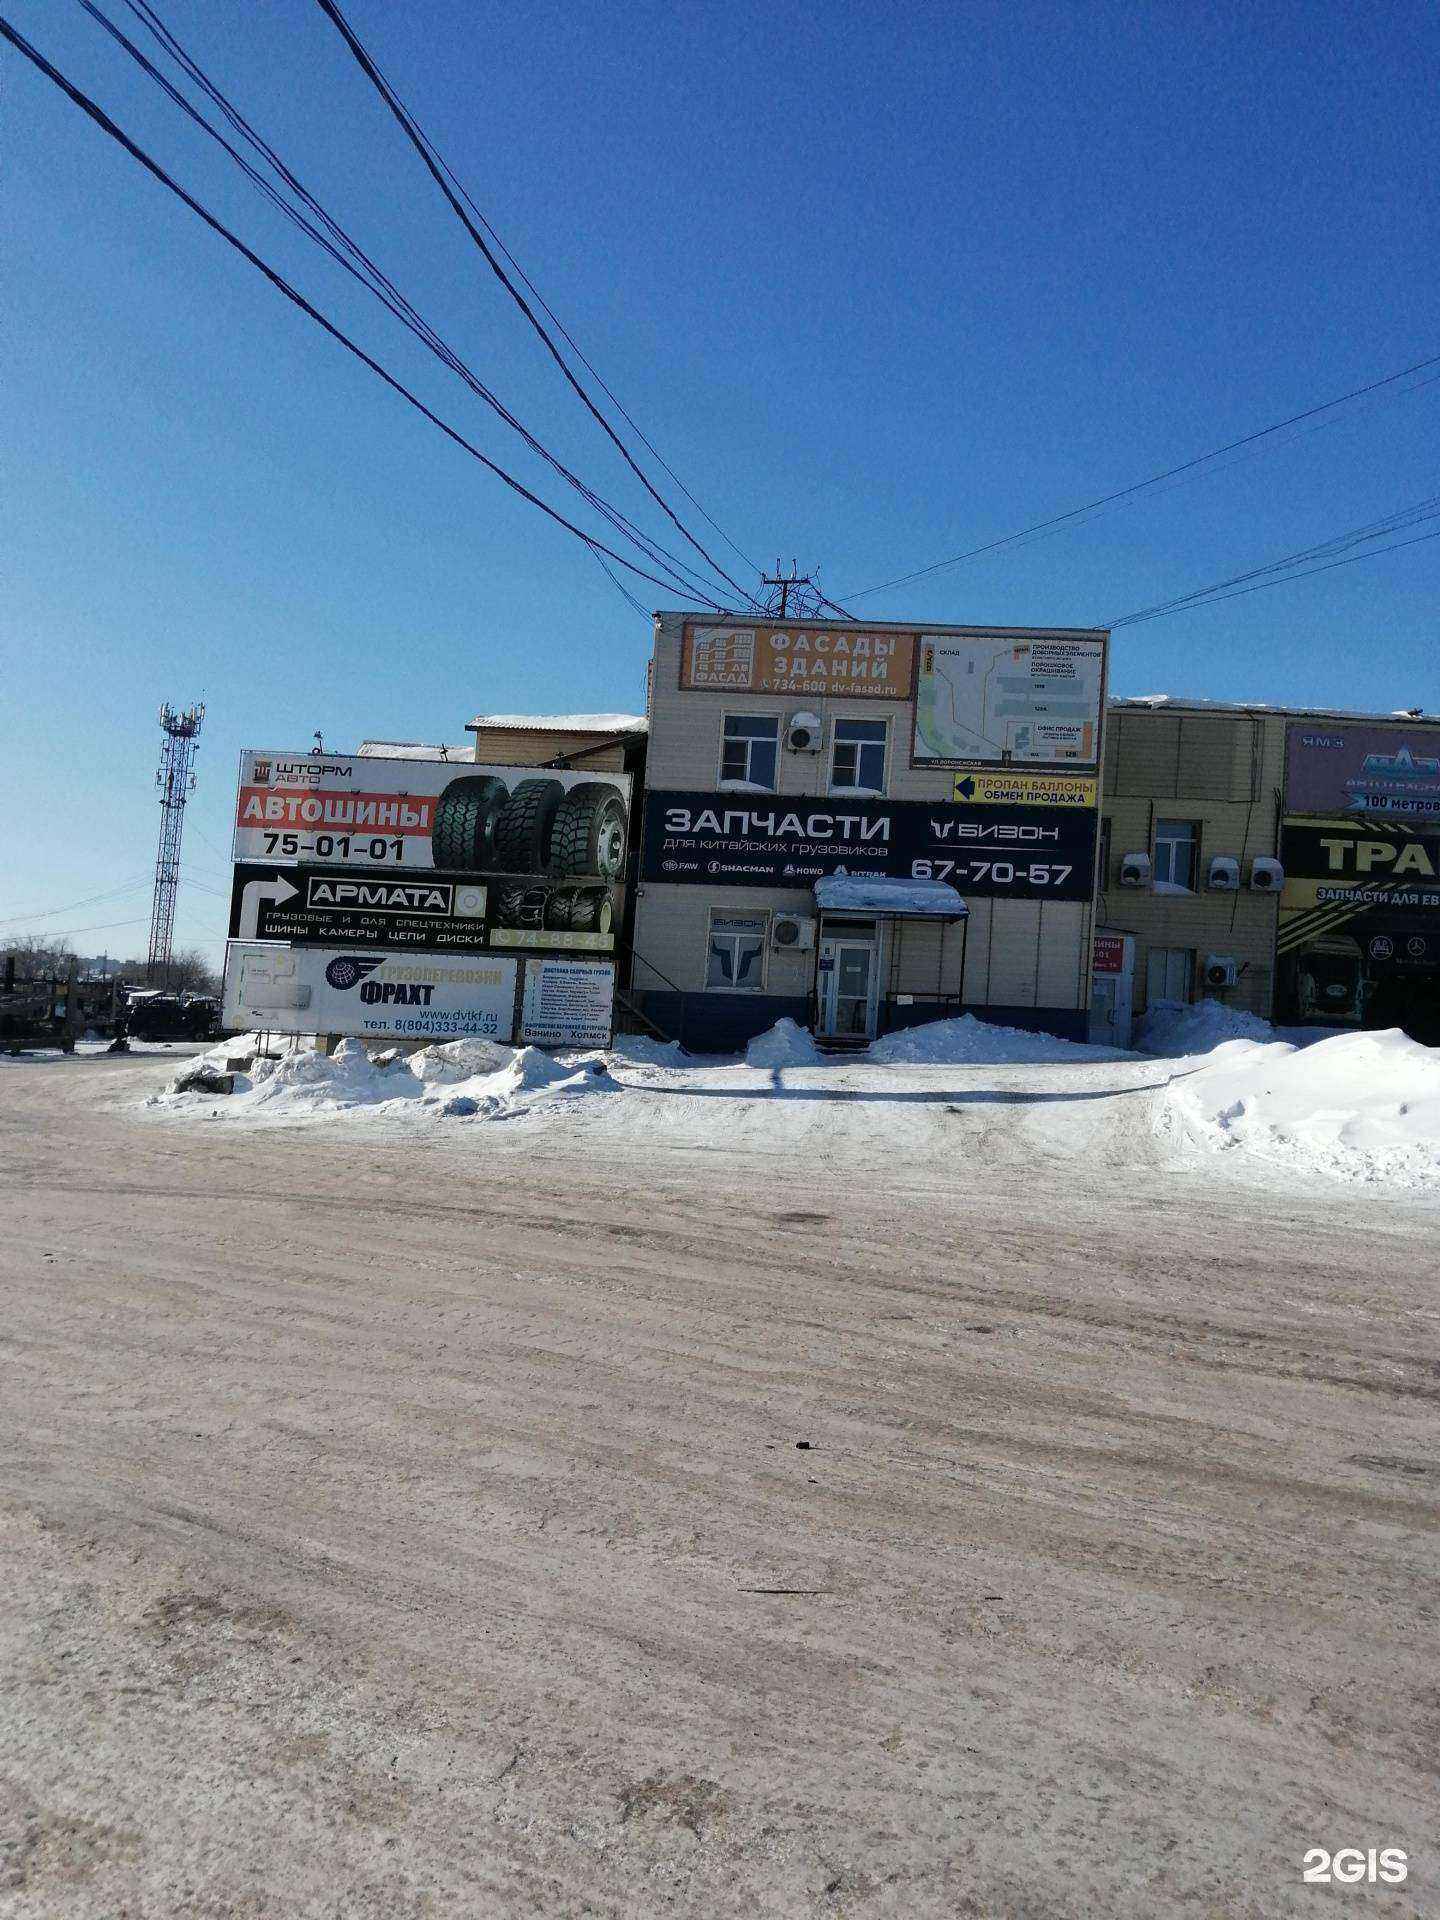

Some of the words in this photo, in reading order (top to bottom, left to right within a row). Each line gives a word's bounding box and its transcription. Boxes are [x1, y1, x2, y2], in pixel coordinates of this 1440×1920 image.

[770, 633, 896, 656] ФАСАДЫ
[774, 655, 887, 679] ЗДАНИЙ
[696, 672, 748, 683] ФАСАД
[772, 678, 826, 692] 734-600
[276, 763, 352, 777] ШТОРМ
[275, 775, 320, 784] АВТО
[978, 778, 1027, 790] ПРОПАН
[1032, 780, 1093, 793] БАЛЛОНЫ
[984, 790, 1022, 801] ОБМЕН
[1027, 792, 1086, 804] ПРОДАЖА
[1365, 795, 1388, 808] 100
[243, 795, 429, 828] АВТОШИНЫ
[664, 809, 891, 841] ЗАПЧАСТИ
[958, 823, 1059, 841] БИЗОН
[264, 832, 404, 861] 75-01-01
[700, 840, 787, 853] китайских
[791, 844, 888, 857] грузовиков
[1320, 839, 1436, 876] ТРА
[721, 864, 774, 874] SHACMAN
[912, 859, 1073, 885] 67-70-57
[312, 884, 446, 908] АРМАТА
[1317, 888, 1388, 903] ЗАПЧАСТИ
[1391, 893, 1418, 905] ДЛЯ
[265, 912, 333, 924] ГРУЗОВЫЕ
[342, 915, 351, 924] И
[361, 917, 386, 926] ДЛЯ
[396, 918, 485, 931] СПЕЦТЕХНИКИ
[713, 919, 764, 929] БИЗОН
[265, 924, 308, 935] ШИНЫ
[319, 927, 378, 939] КАМЕРЫ
[388, 931, 426, 942] ЦЕПИ
[436, 934, 483, 944] ДИСКИ
[360, 981, 435, 1006] ФРАХТ
[420, 1009, 498, 1023] www.dvtkf.ru
[364, 1019, 390, 1031] тел.
[395, 1019, 497, 1035] 8(804)333-44-32
[525, 1028, 561, 1038] Ванино
[571, 1030, 607, 1040] Холмск
